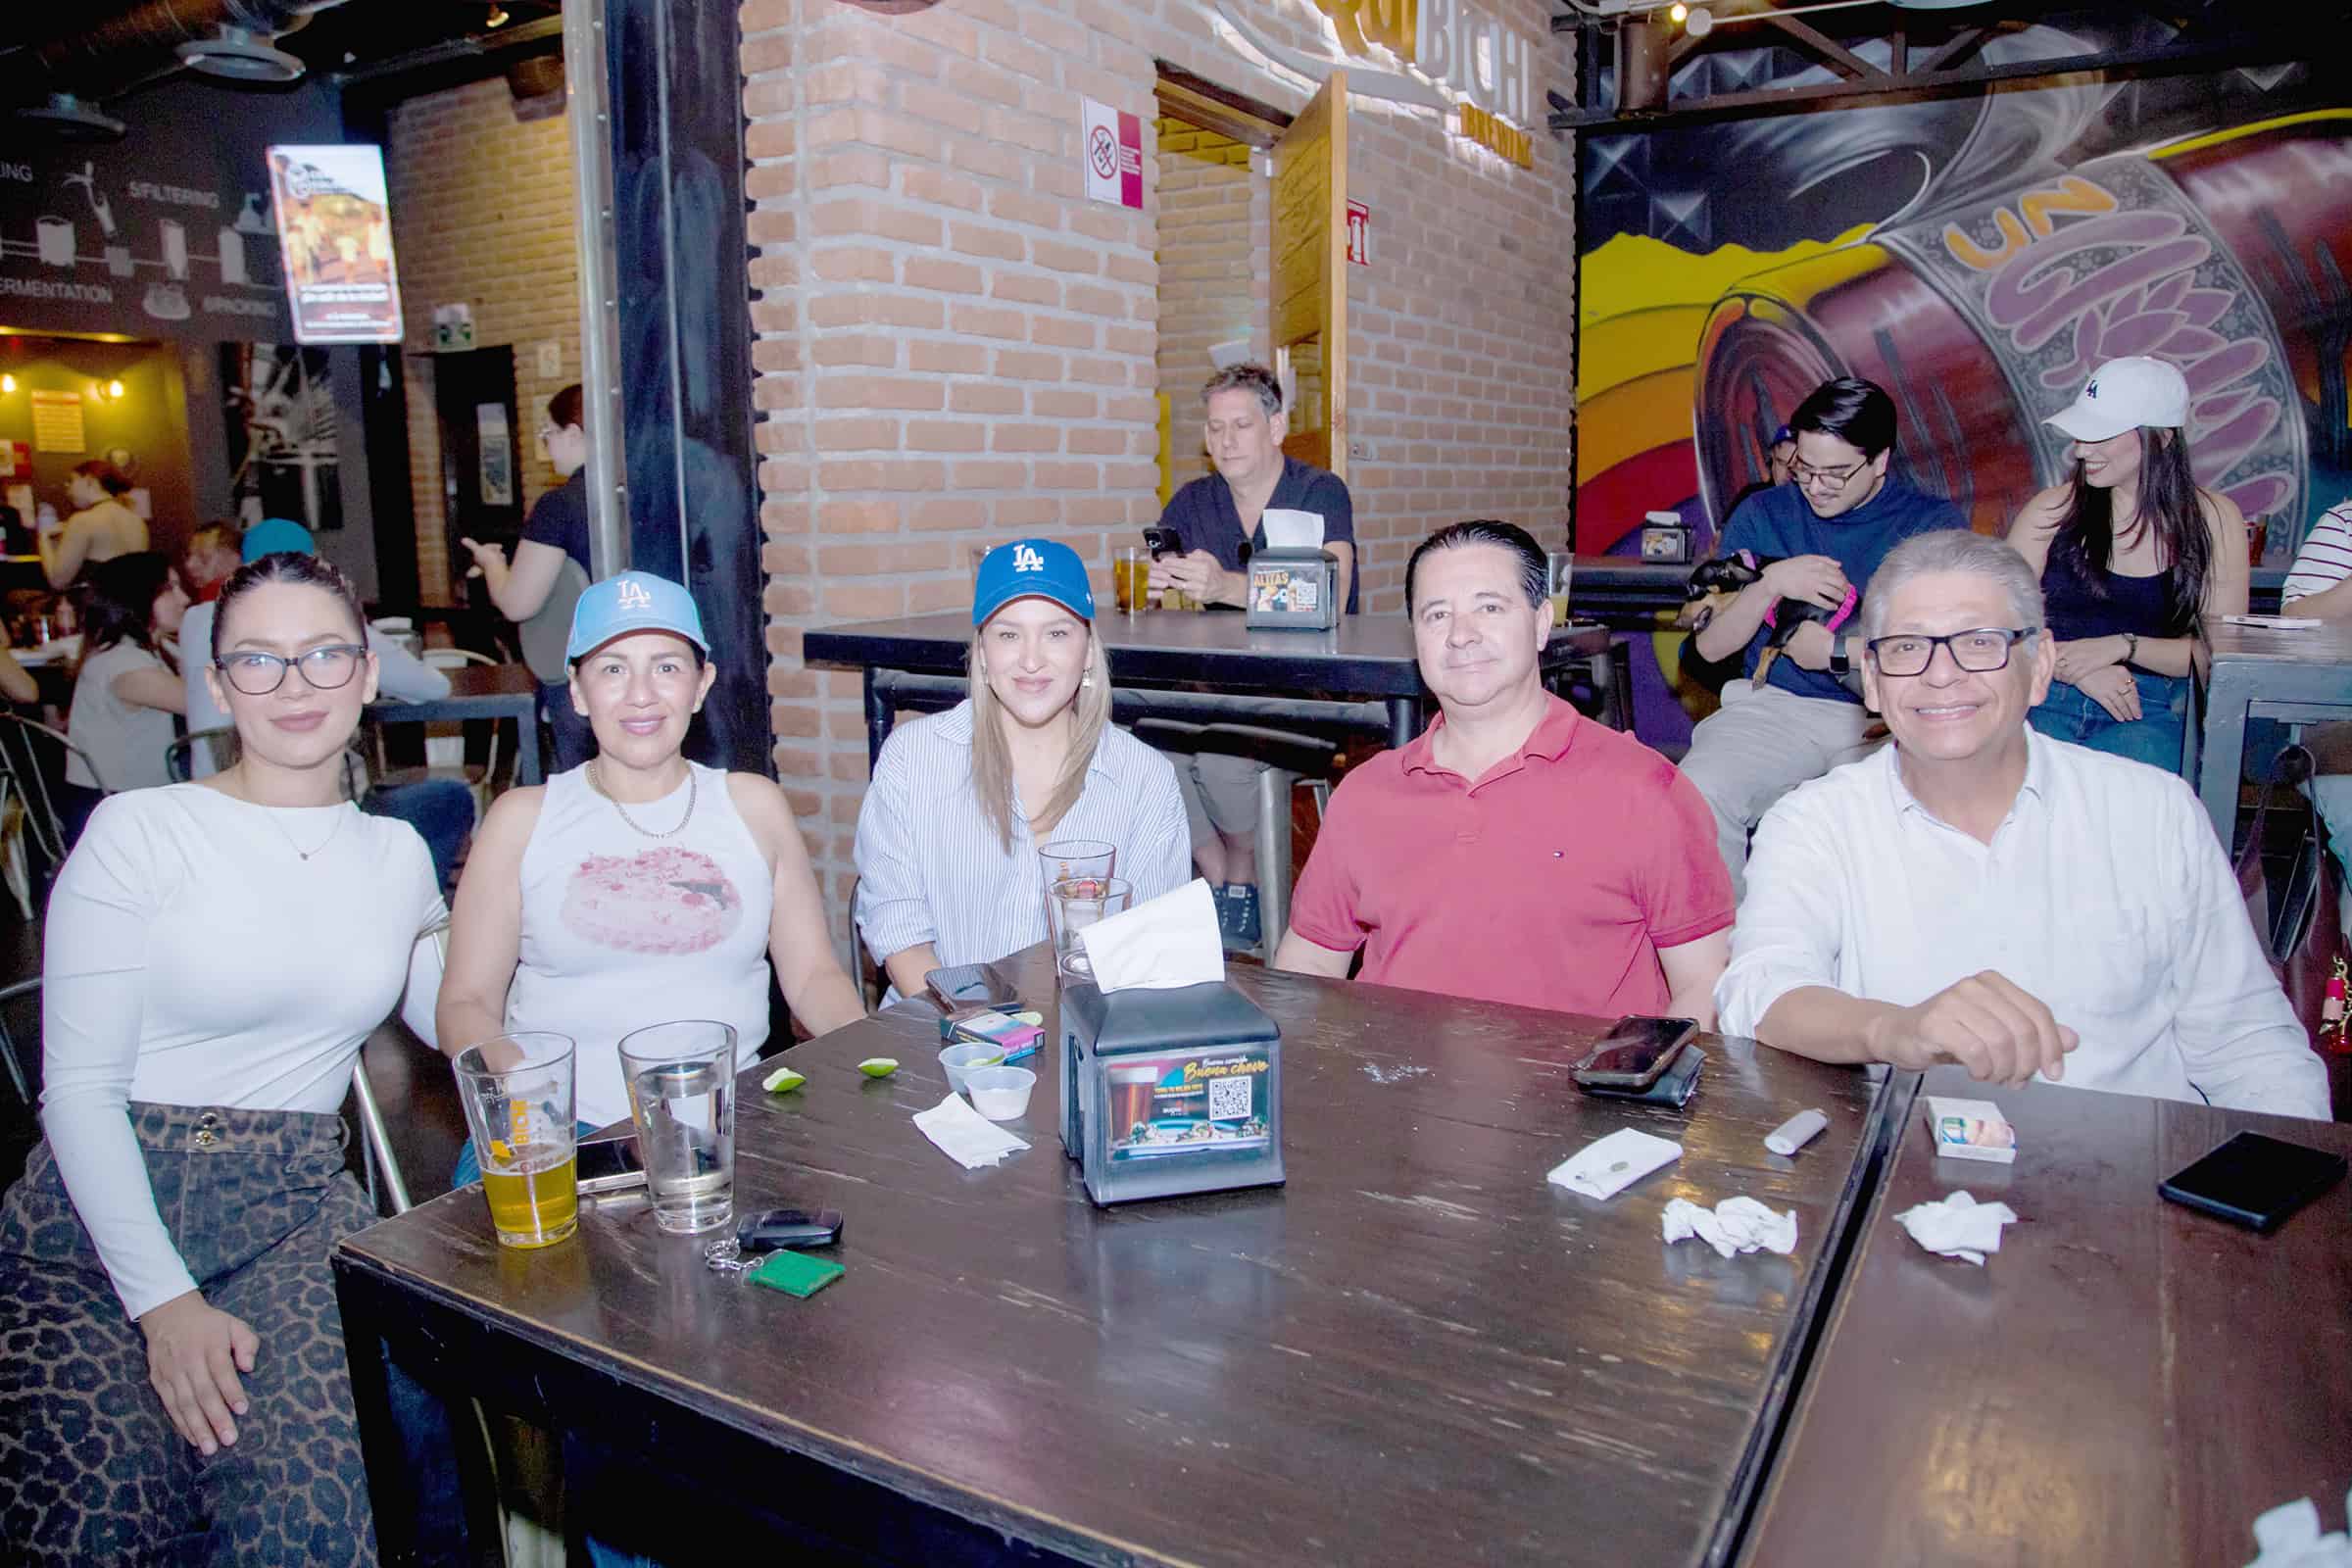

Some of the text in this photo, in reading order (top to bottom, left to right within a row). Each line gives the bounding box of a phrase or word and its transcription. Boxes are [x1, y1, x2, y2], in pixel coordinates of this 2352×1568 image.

[1942, 175, 2118, 270] UN
[1012, 544, 1044, 572] LA
[616, 579, 651, 610] LA
